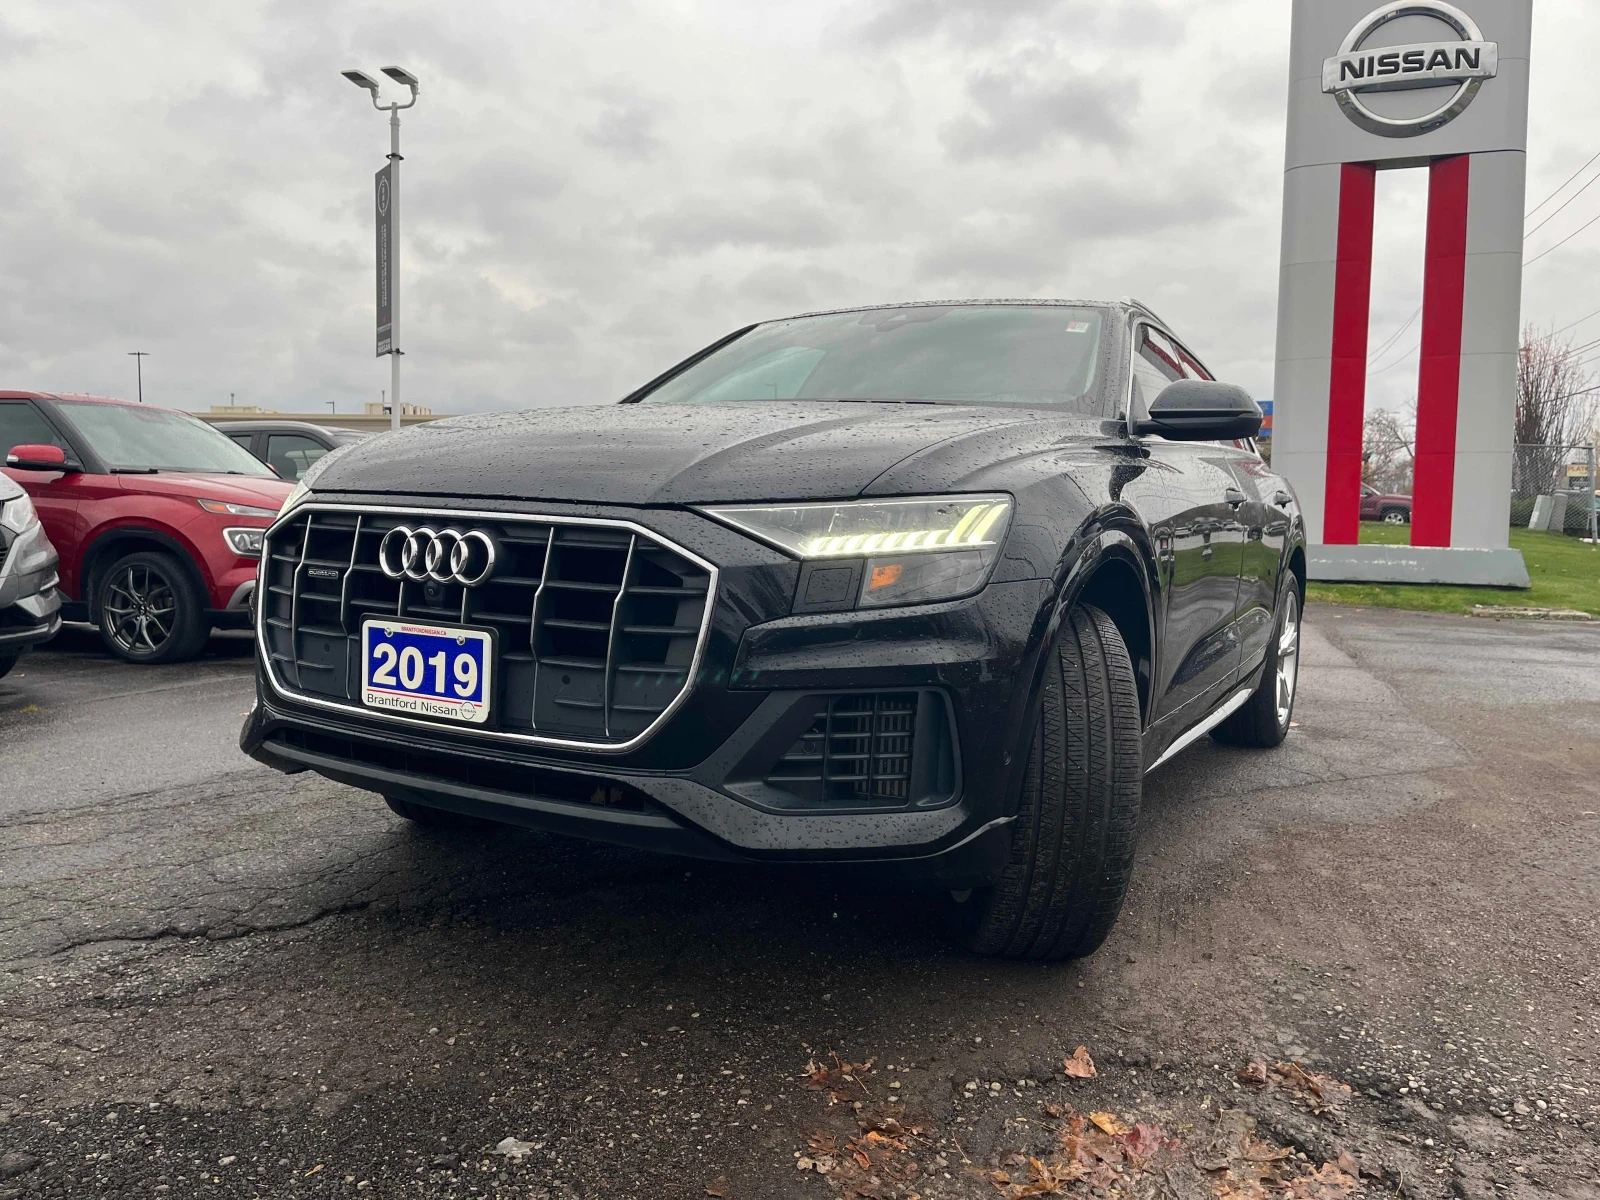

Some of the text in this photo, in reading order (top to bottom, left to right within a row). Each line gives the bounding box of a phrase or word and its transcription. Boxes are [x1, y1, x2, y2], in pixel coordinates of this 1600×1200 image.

[1340, 48, 1481, 81] NISSAN
[401, 626, 447, 636] BRANTFORDNISSAN.CA
[372, 642, 478, 697] 2019
[367, 694, 458, 716] Brantford Nissan
